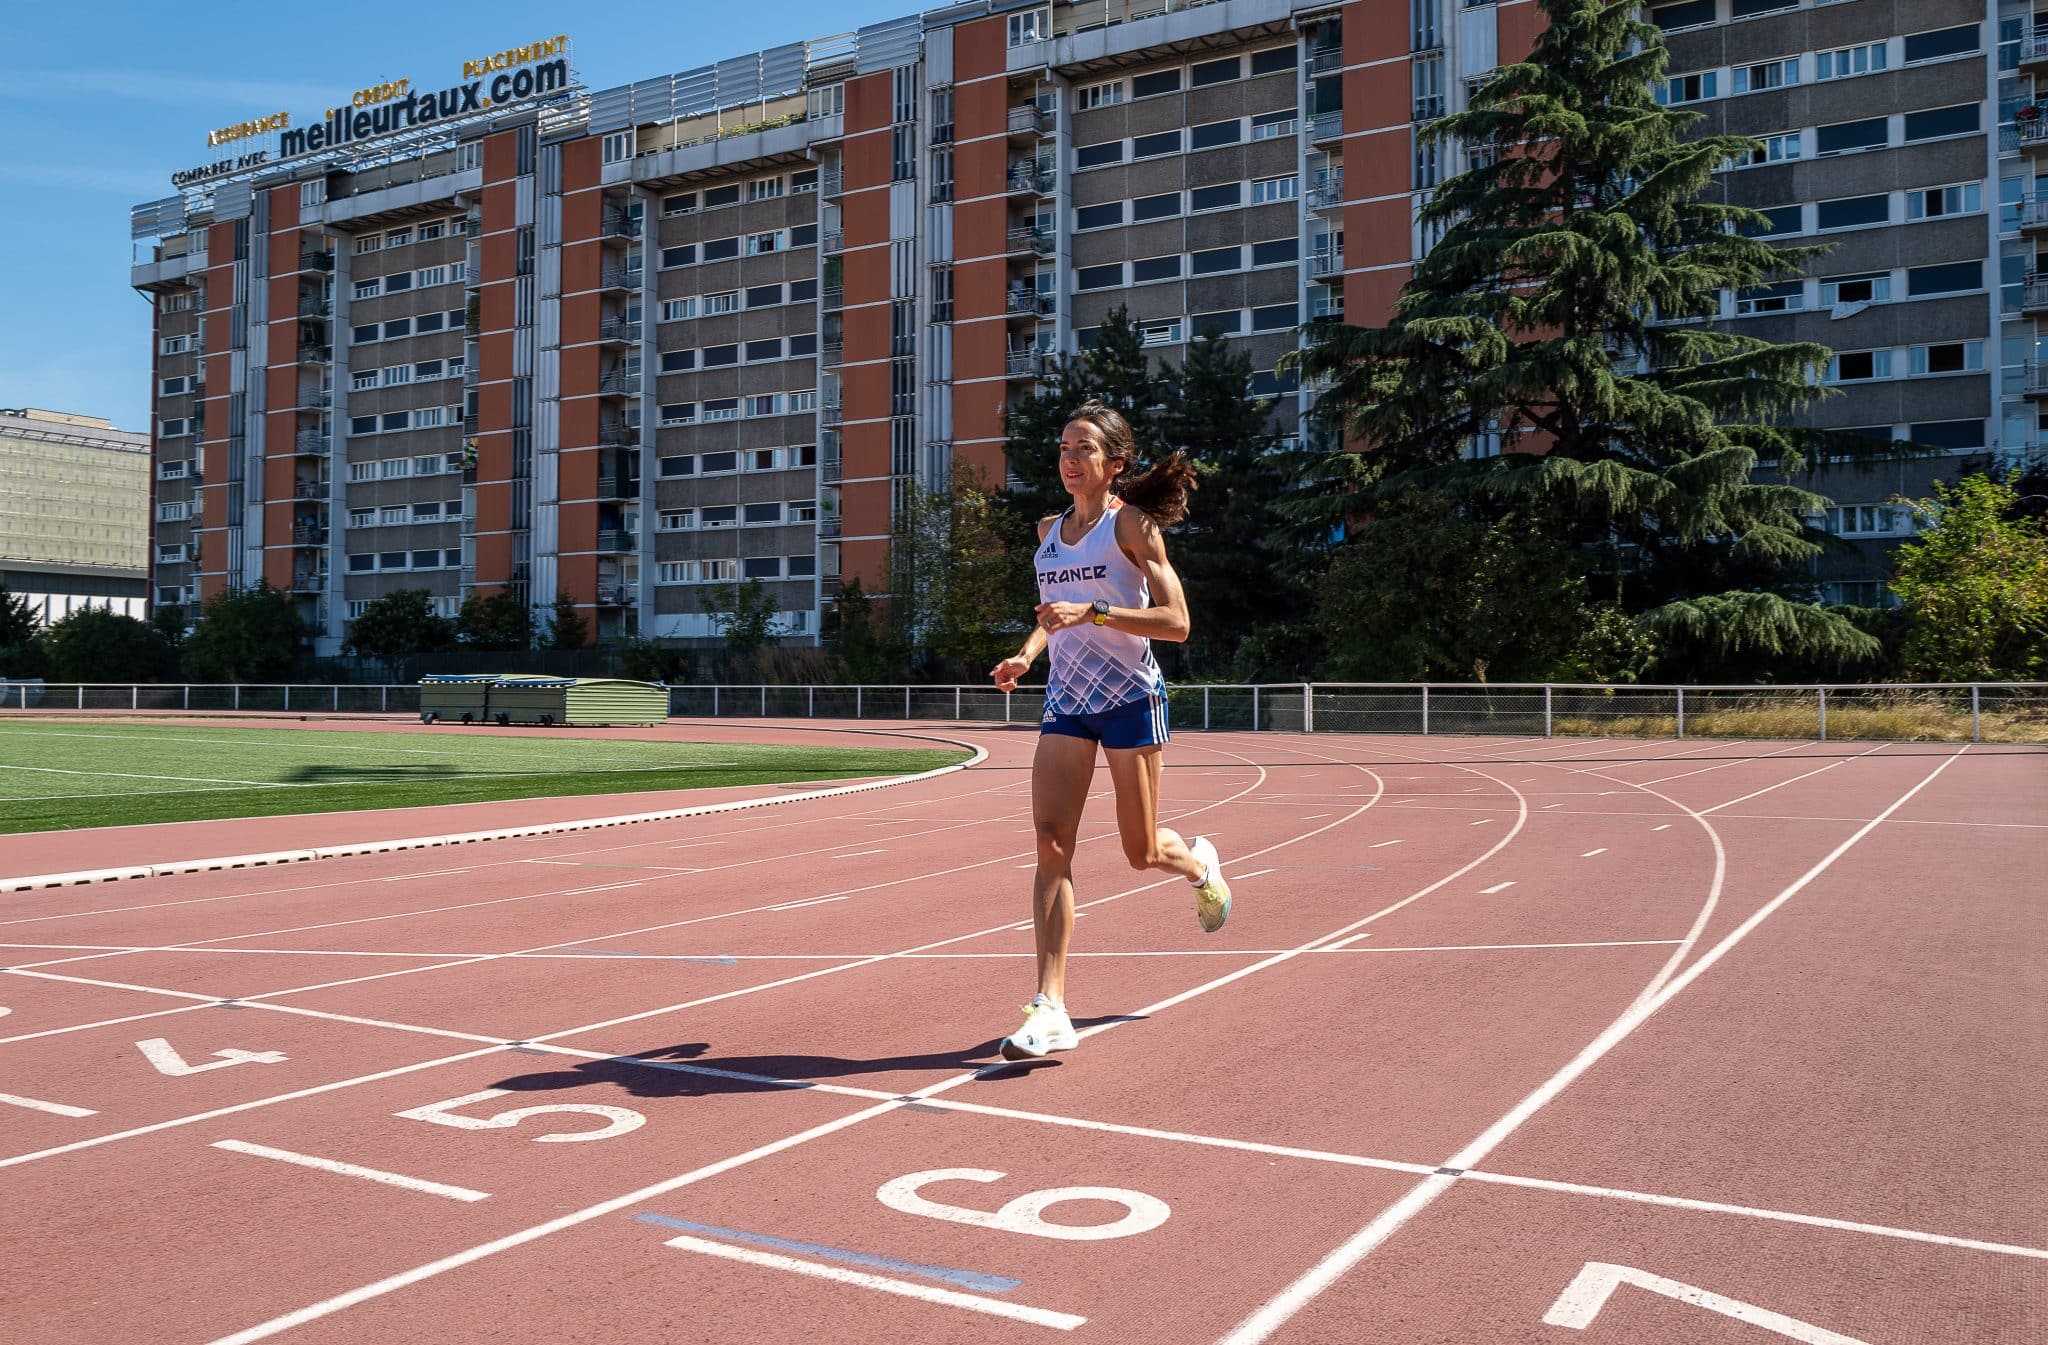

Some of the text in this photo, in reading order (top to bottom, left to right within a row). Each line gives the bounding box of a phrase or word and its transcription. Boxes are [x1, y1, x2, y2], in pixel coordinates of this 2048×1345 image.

[463, 34, 569, 79] PLACEMENT
[353, 79, 410, 107] CREDIT
[171, 160, 233, 186] COMPAREZ
[237, 151, 267, 170] AVEC
[280, 58, 568, 158] meilleurtaux.com
[208, 111, 289, 148] ASSURANCE
[1038, 565, 1107, 586] FRANCE
[135, 1037, 289, 1077] 4
[392, 1087, 647, 1144] 5
[875, 1166, 1172, 1241] 6
[1541, 1261, 1870, 1345] 7
